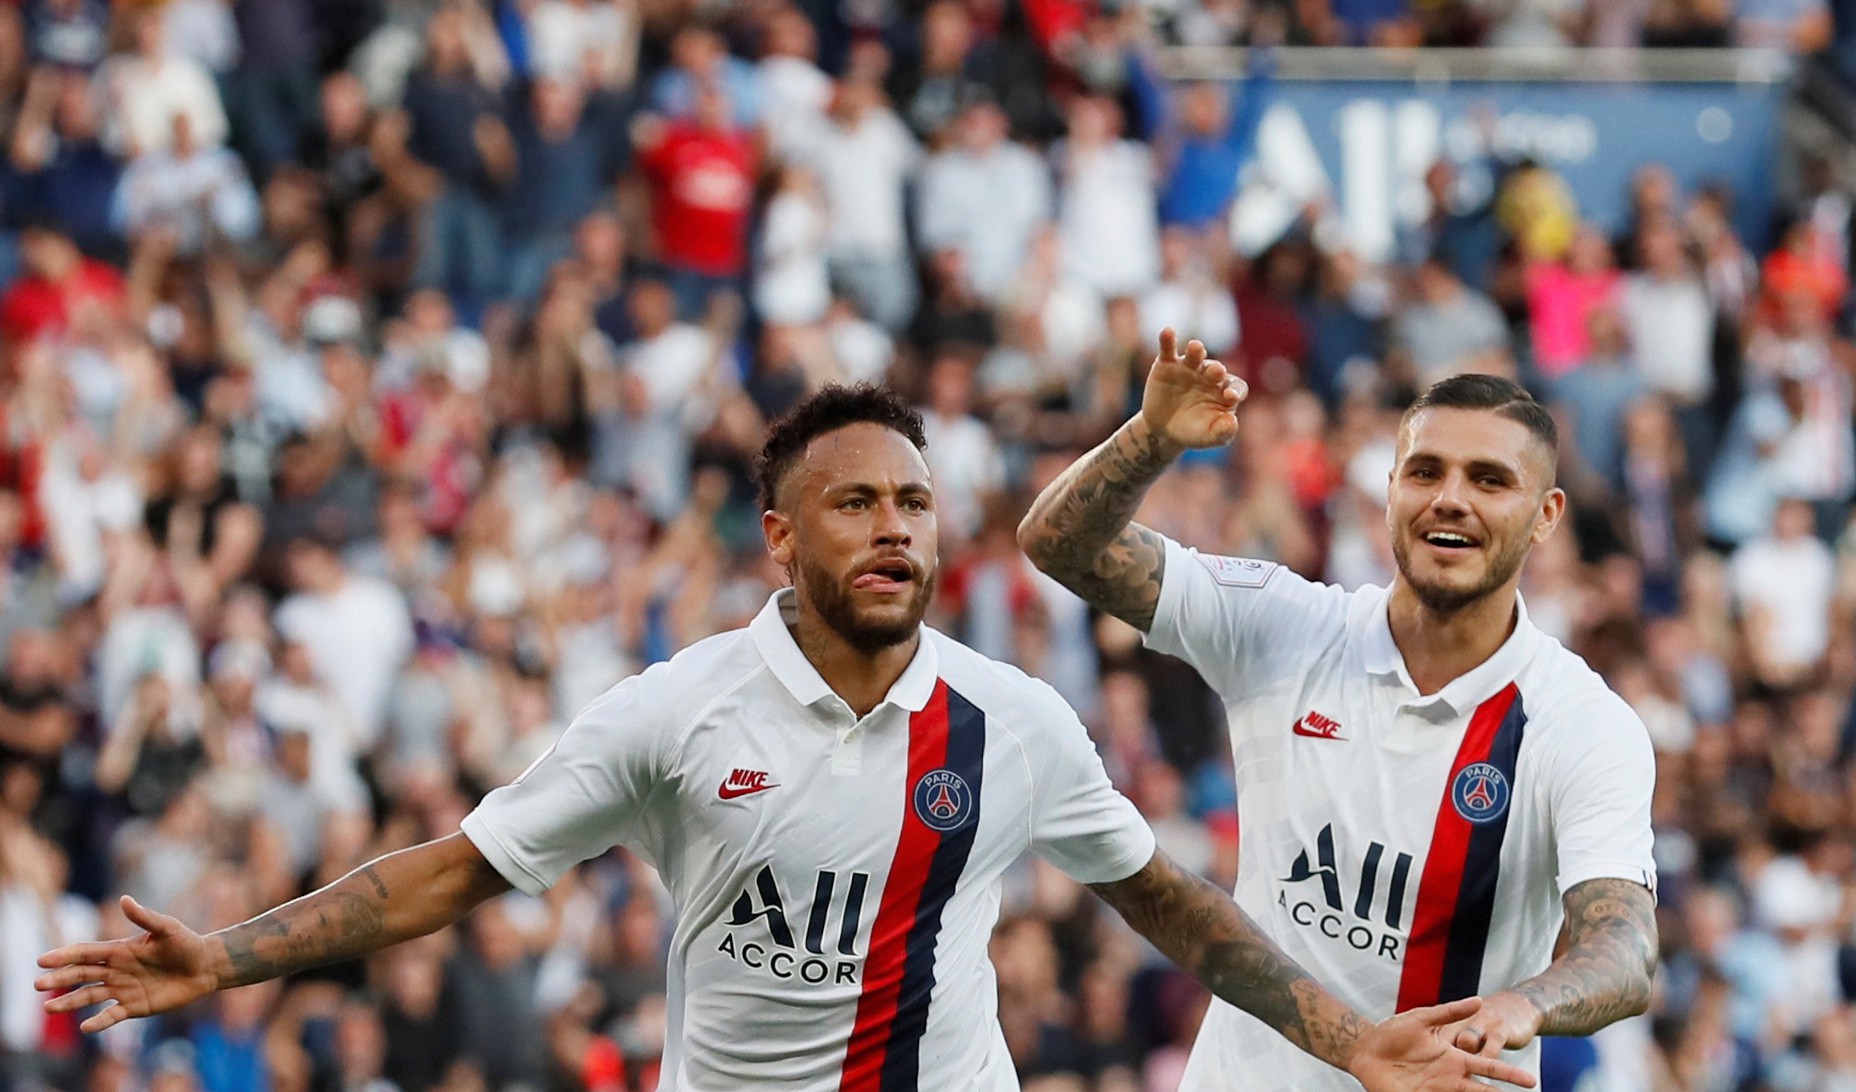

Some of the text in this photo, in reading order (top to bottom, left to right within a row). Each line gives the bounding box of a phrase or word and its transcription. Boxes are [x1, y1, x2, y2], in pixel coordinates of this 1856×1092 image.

[1304, 711, 1342, 735] NIKE
[728, 768, 769, 788] NIKE
[925, 773, 962, 789] PARIS
[1466, 767, 1501, 784] PARIS
[1278, 889, 1400, 961] ACCOR
[717, 932, 857, 984] ACCOR
